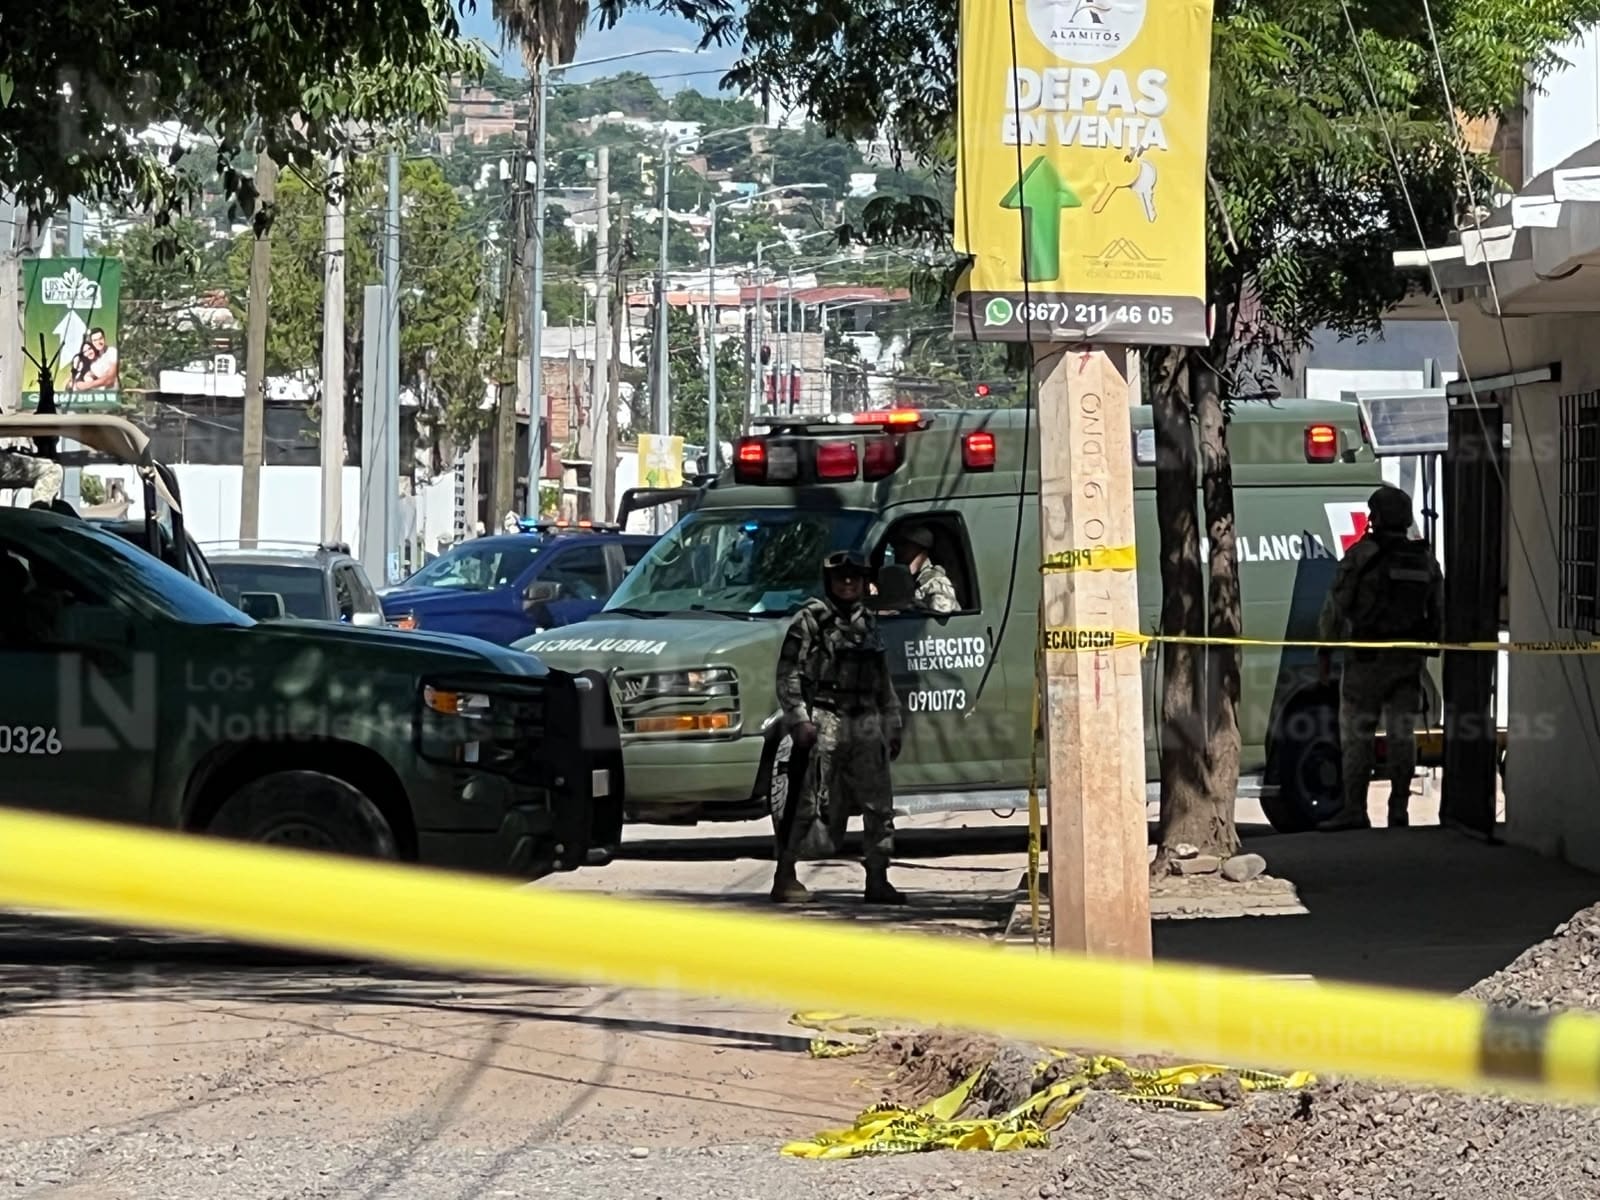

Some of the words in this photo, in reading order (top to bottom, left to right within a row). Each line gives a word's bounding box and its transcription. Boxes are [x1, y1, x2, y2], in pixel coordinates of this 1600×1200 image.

[1050, 30, 1120, 41] ALAMITOS
[1006, 67, 1168, 116] DEPAS
[1002, 112, 1048, 147] EN
[1053, 115, 1168, 151] VENTA
[1015, 302, 1069, 324] (667)
[1075, 303, 1108, 324] 211
[1116, 305, 1142, 324] 46
[1148, 306, 1174, 325] 05
[904, 635, 985, 657] EJÉRCITO
[907, 654, 985, 671] MEXICANO
[908, 688, 966, 712] 0910173
